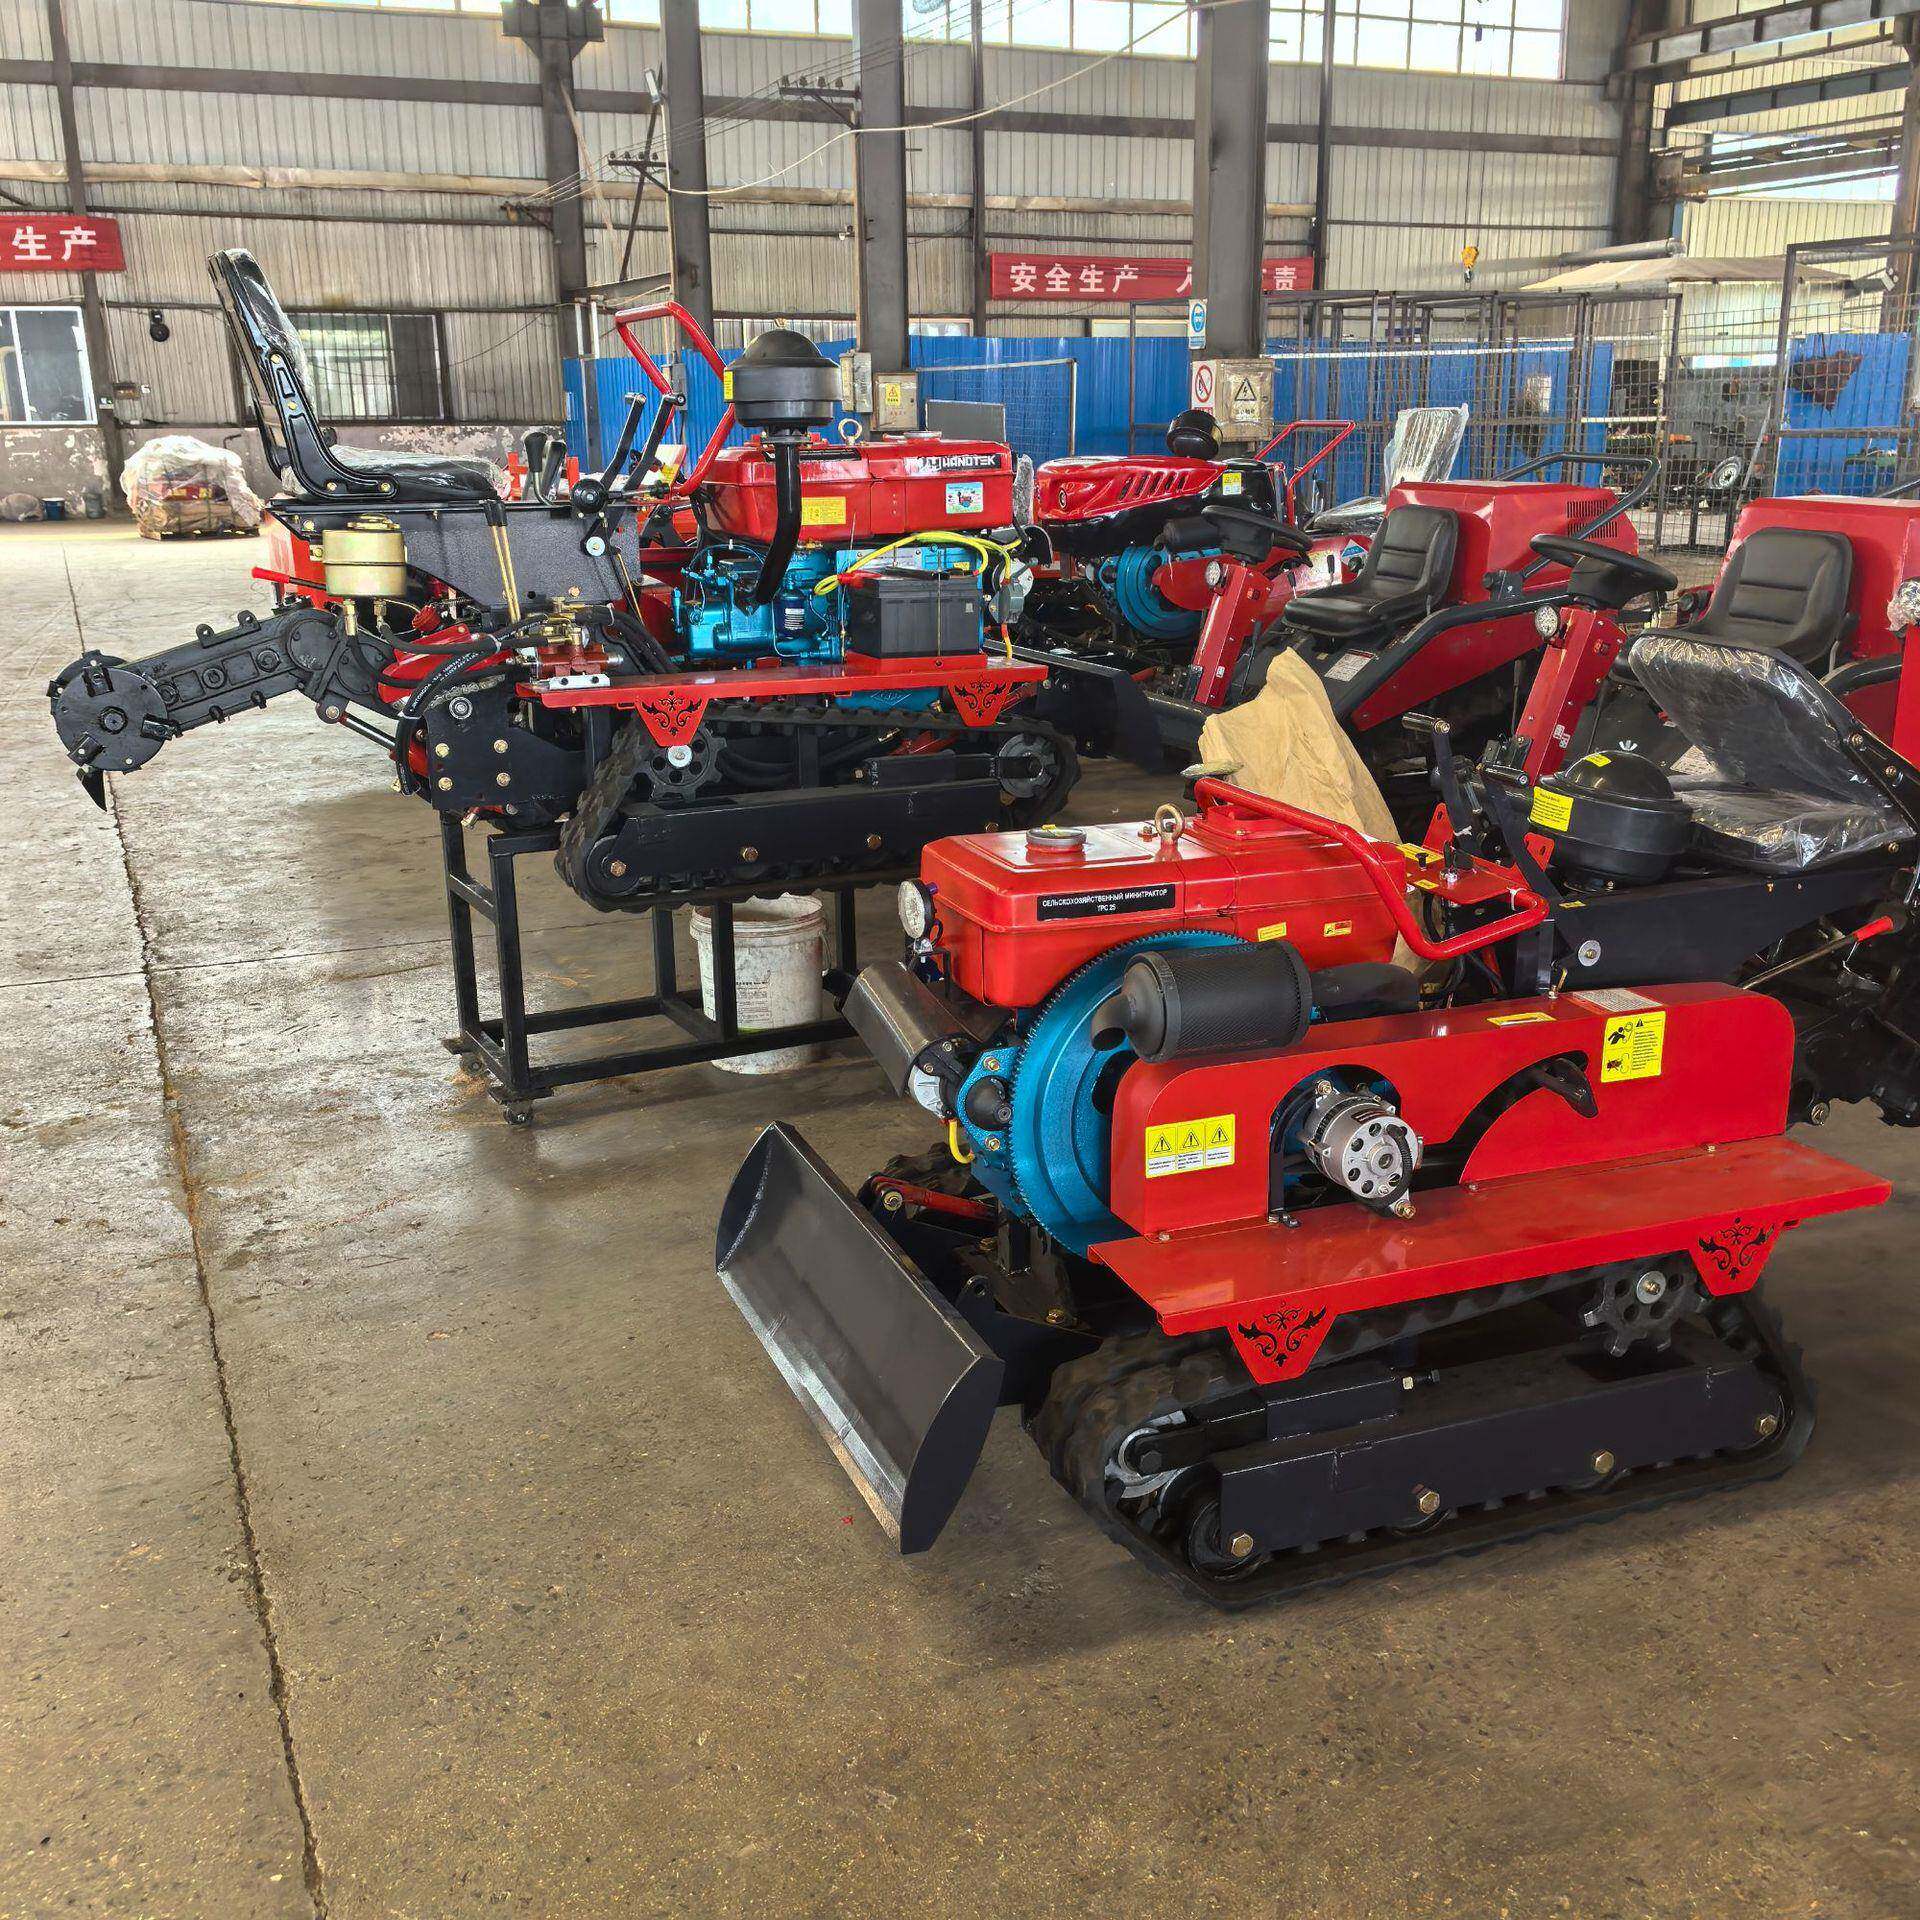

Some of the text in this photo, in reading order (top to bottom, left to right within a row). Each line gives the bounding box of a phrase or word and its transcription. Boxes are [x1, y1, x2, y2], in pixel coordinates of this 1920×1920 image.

[1010, 262, 1139, 293] 安全生产
[1042, 888, 1168, 907] СЕЛЬСКОХОЗЯЙСТВЕННЫЙ МИНИТРАКТОР
